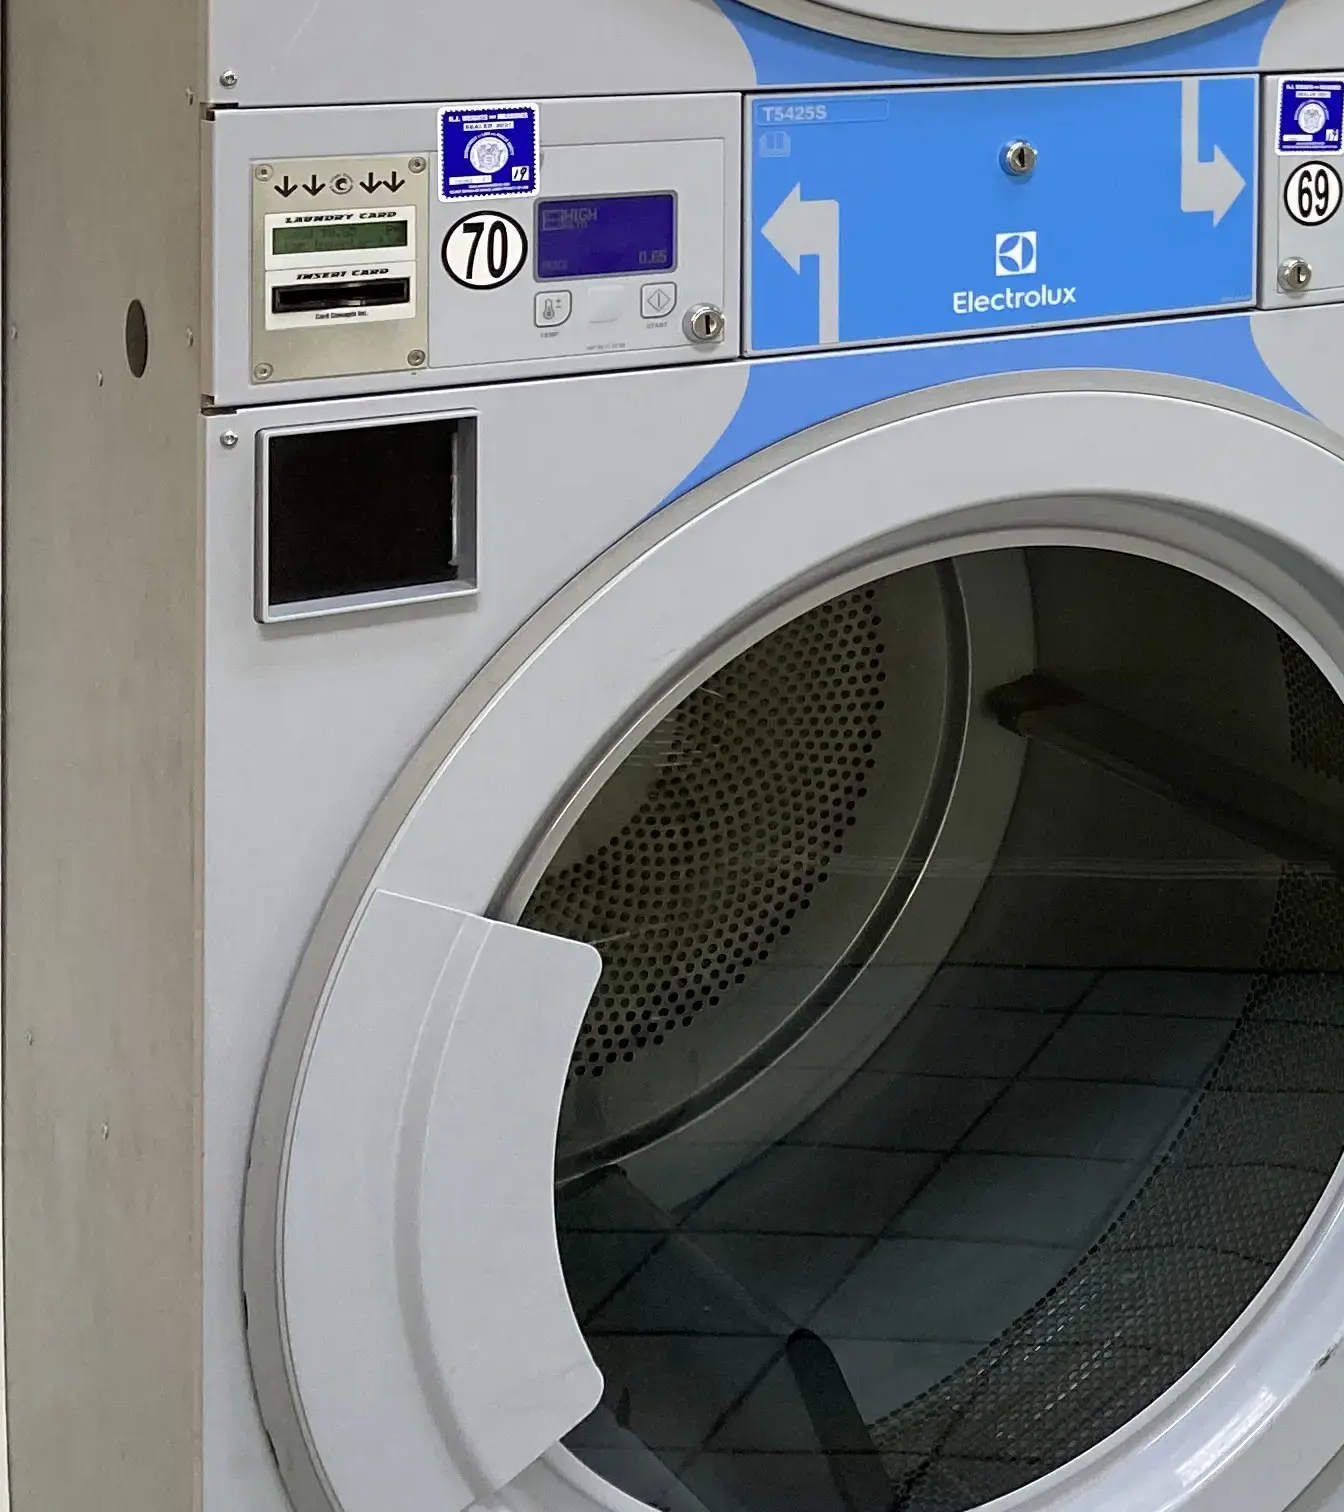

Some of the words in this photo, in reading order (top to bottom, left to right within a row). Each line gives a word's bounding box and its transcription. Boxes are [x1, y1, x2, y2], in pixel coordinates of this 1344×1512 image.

[762, 104, 828, 122] T5425S
[1297, 168, 1329, 218] 69
[285, 212, 354, 224] LAUNDRY
[359, 211, 397, 220] CARD
[462, 219, 509, 280] 70
[296, 270, 347, 281] INSERT
[351, 268, 390, 277] CARD
[952, 283, 1077, 315] Electrolux
